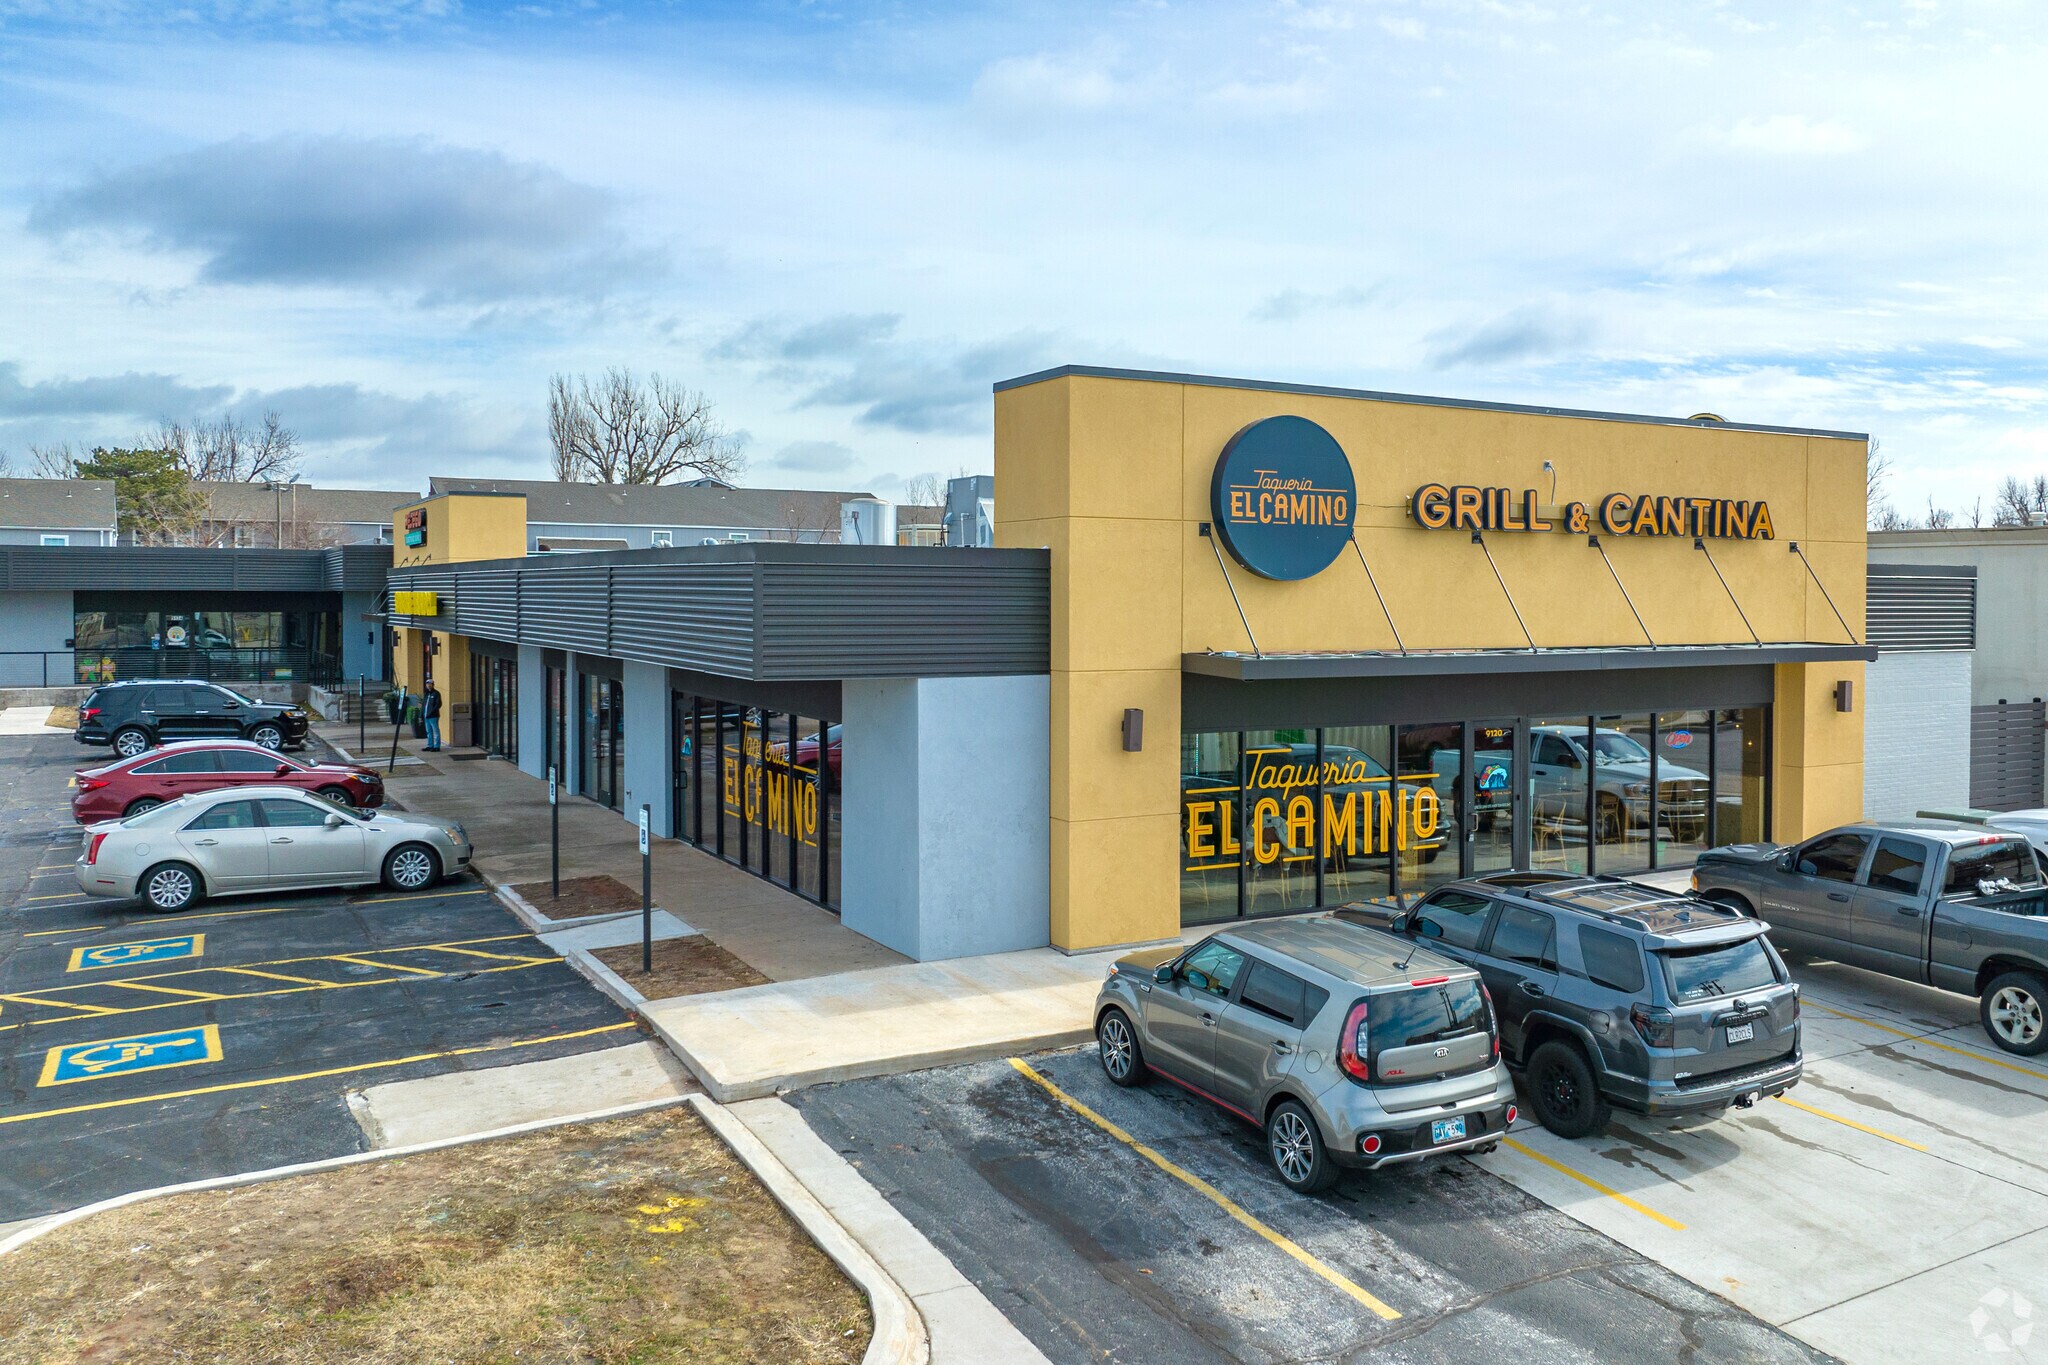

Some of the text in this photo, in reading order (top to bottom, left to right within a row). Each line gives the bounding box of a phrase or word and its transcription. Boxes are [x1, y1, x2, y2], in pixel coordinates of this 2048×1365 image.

[1254, 470, 1313, 495] Taqueria
[1412, 483, 1775, 540] GRILL & CANTINA
[1485, 729, 1503, 738] 9120
[1246, 748, 1367, 800] Taqueria
[1436, 1049, 1448, 1057] KIA
